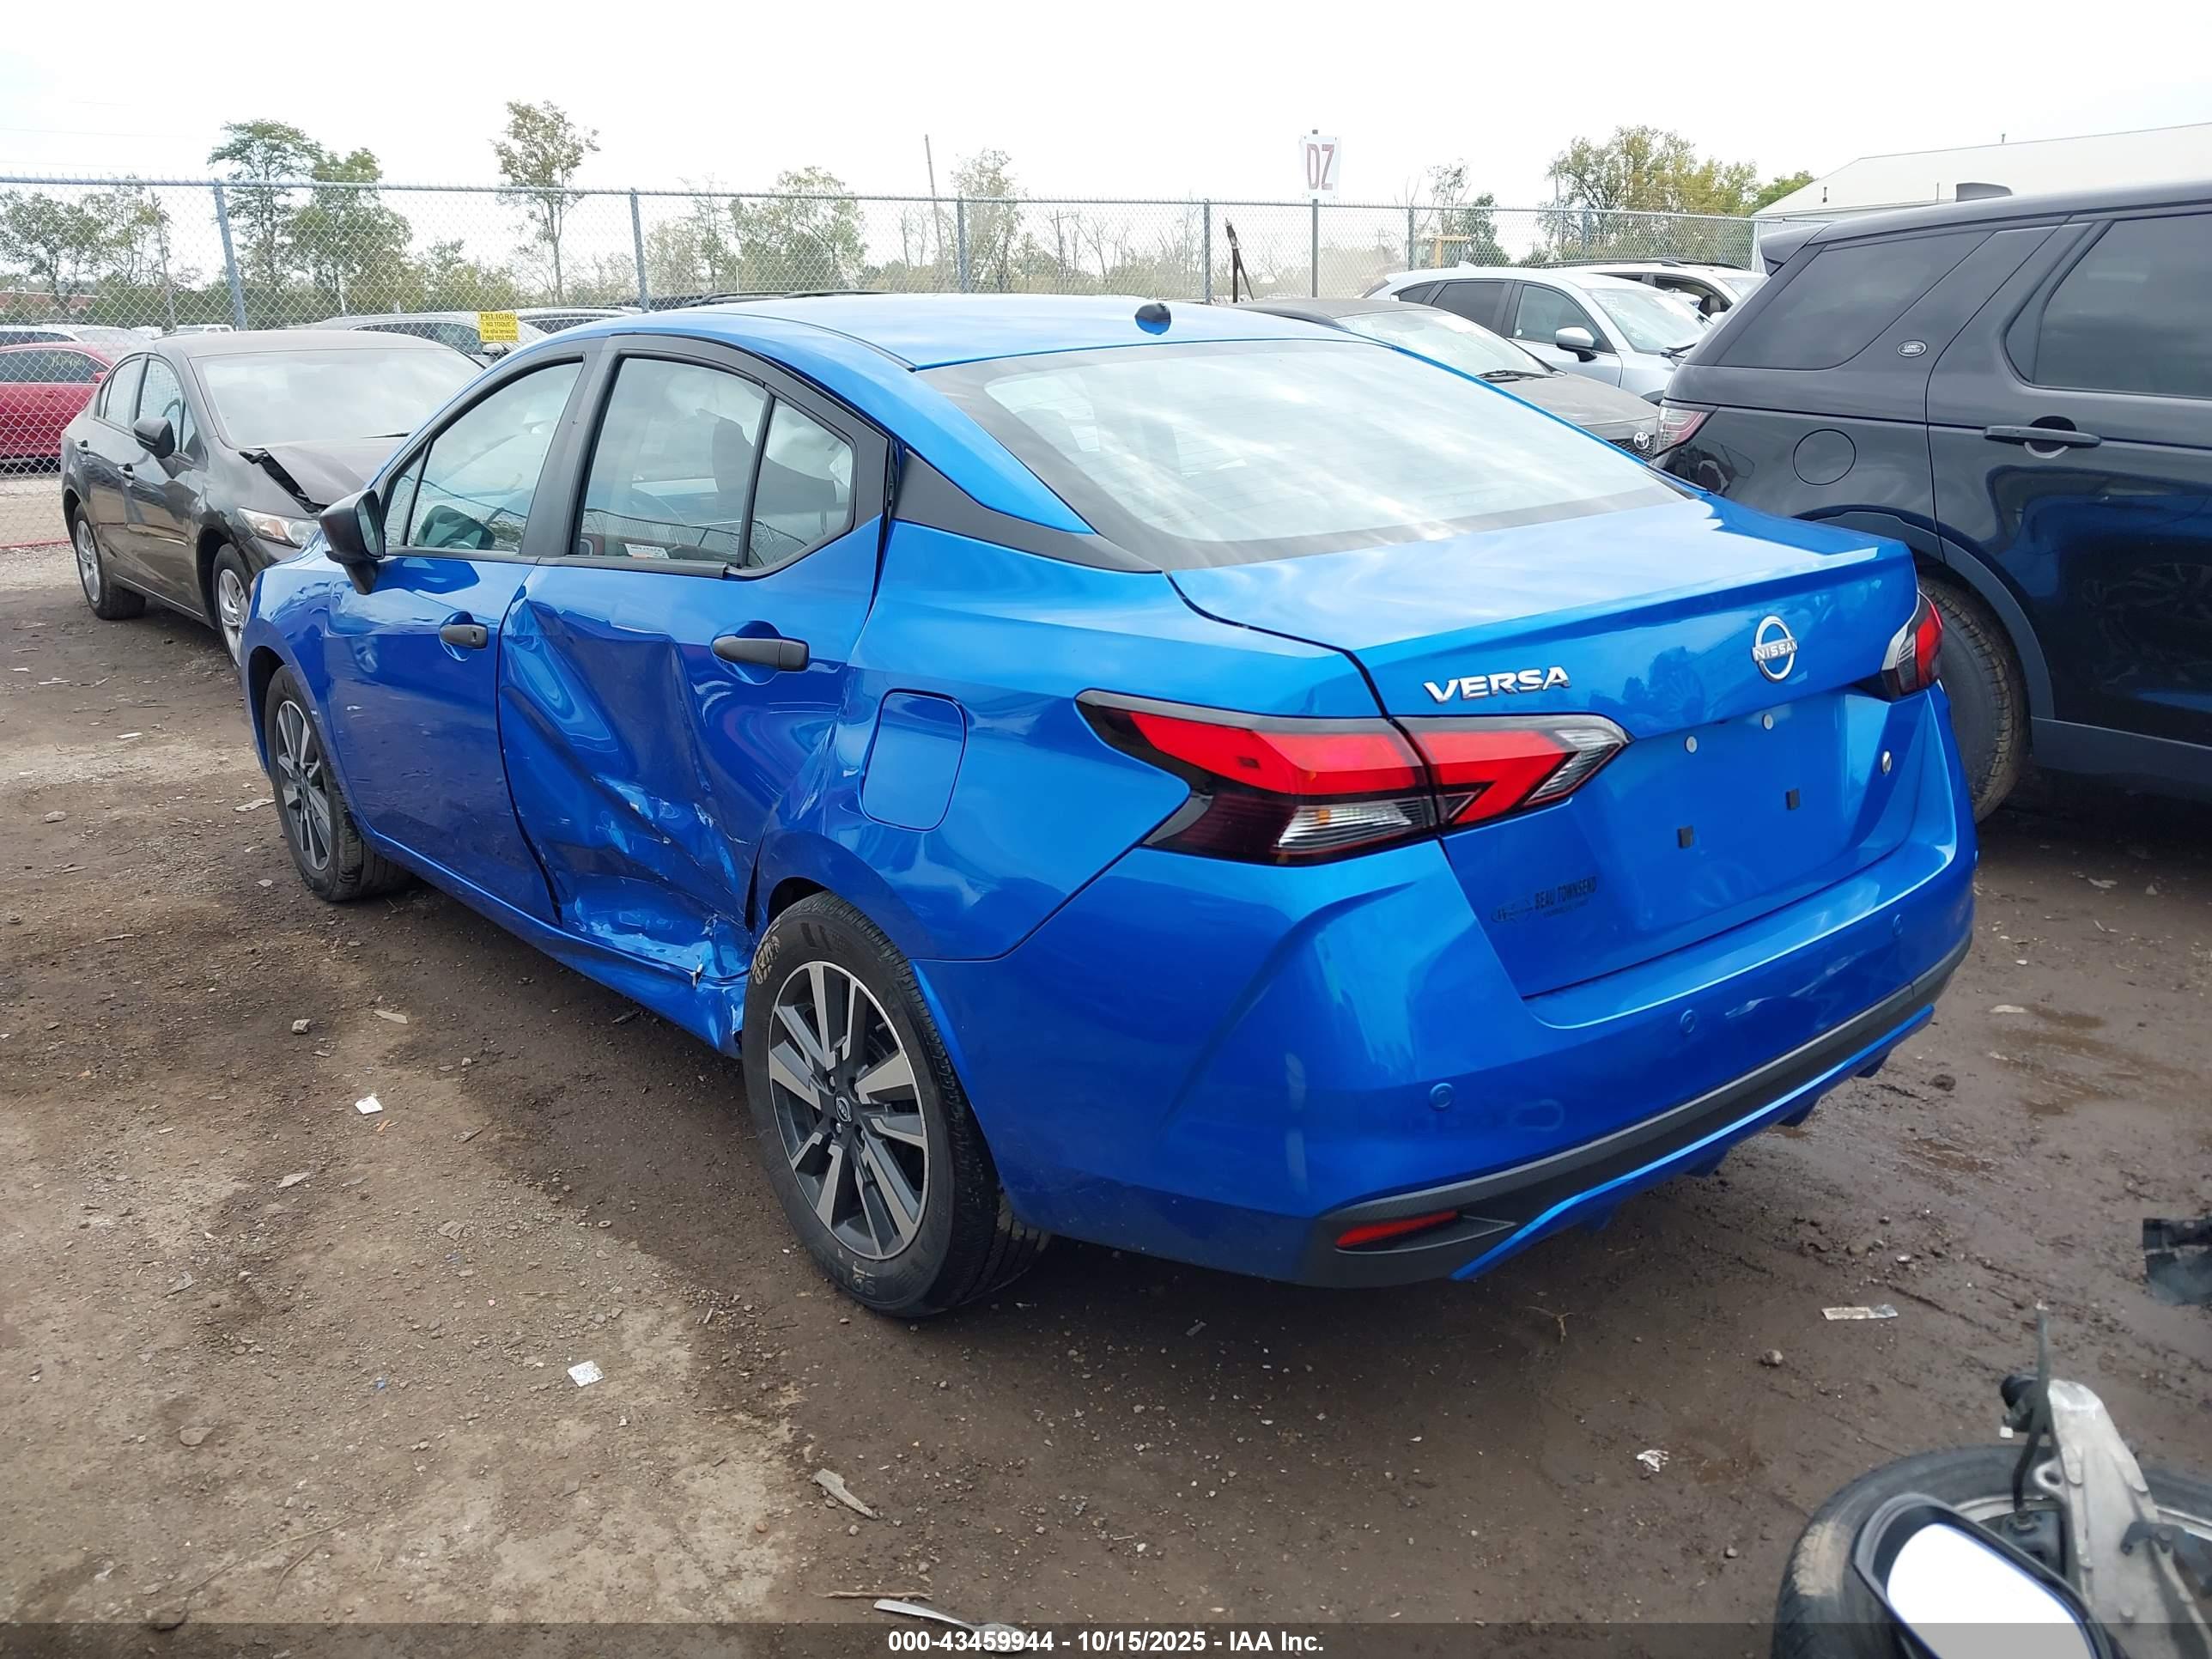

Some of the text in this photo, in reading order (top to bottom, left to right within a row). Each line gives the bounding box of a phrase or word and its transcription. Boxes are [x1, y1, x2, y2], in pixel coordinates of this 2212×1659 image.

[1306, 143, 1334, 190] DZ
[1754, 641, 1798, 660] NISSAN
[1422, 665, 1571, 704] VERSA
